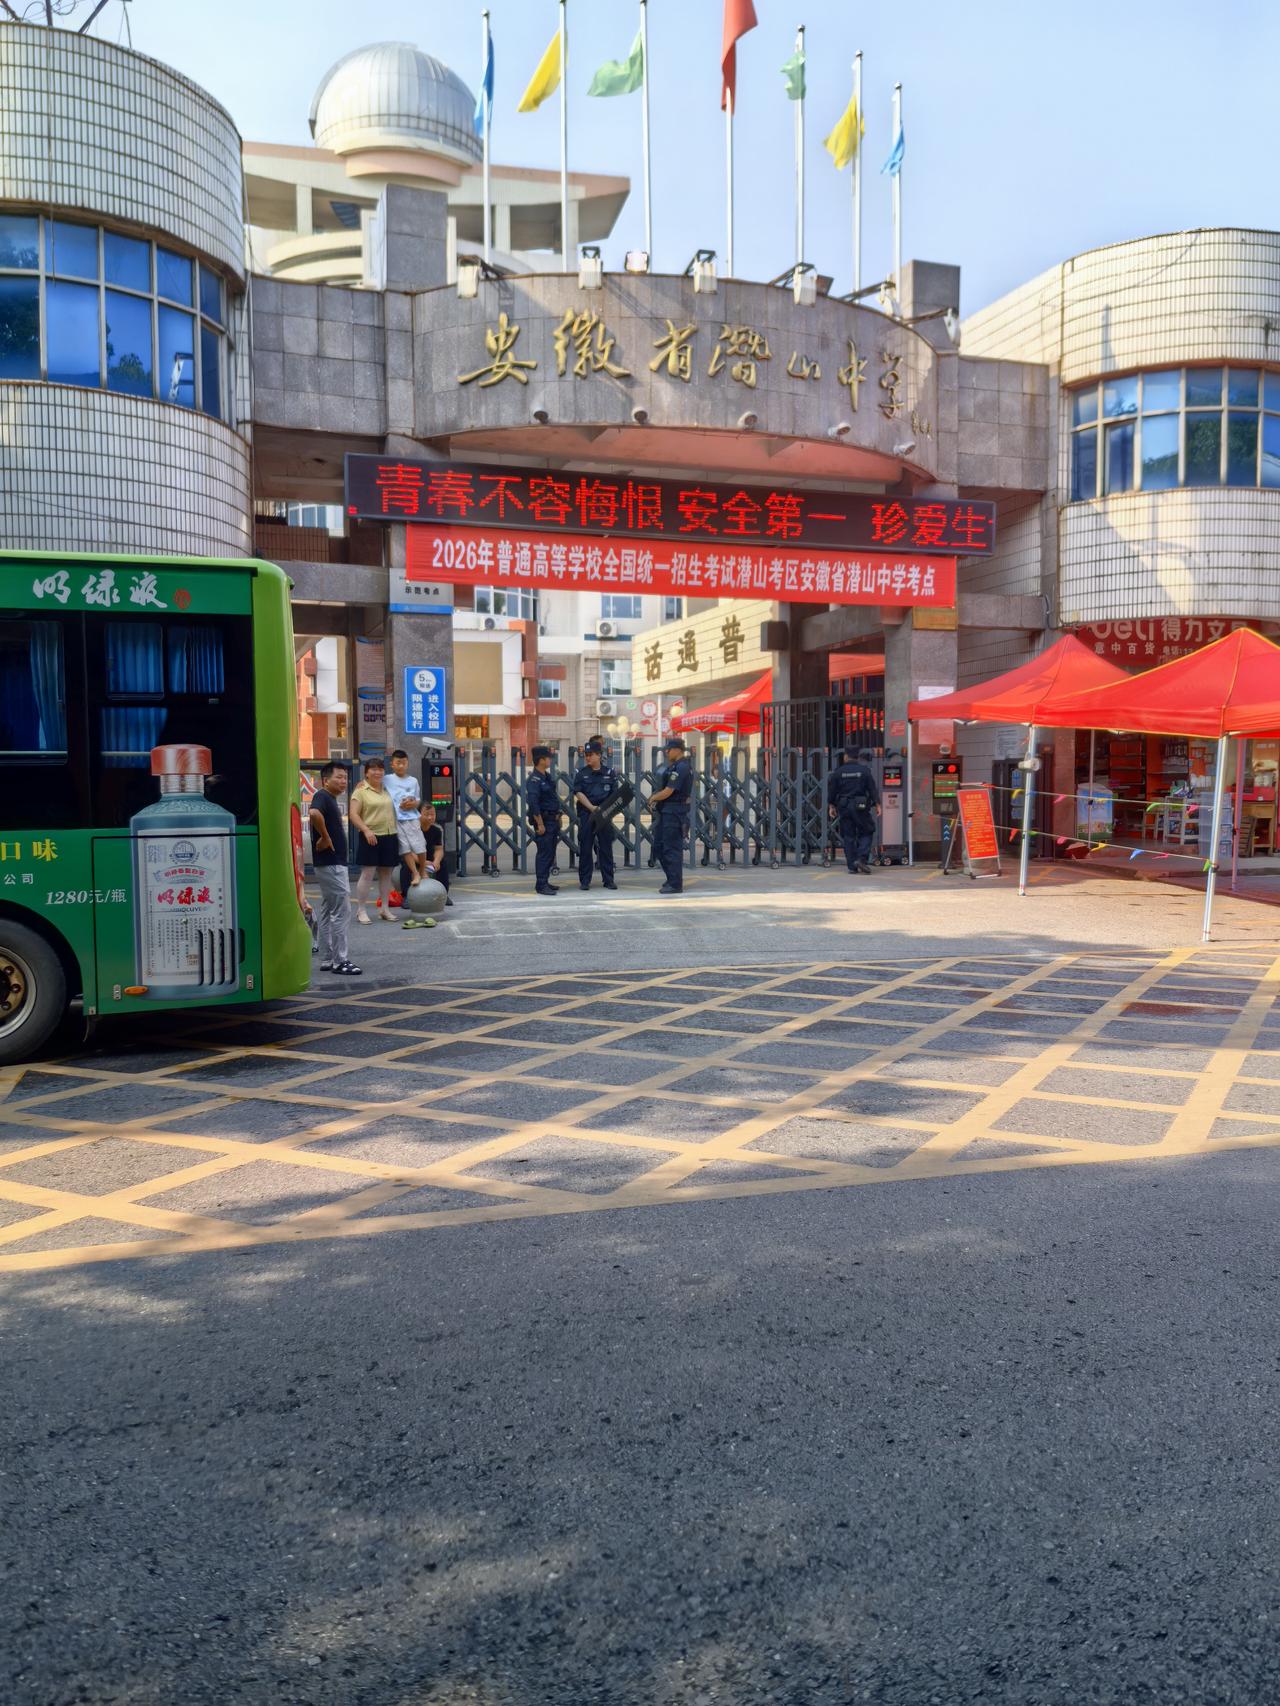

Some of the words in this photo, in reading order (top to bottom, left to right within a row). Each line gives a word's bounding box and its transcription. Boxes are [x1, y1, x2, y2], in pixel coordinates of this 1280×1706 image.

[678, 487, 847, 539] 安全第一
[432, 538, 935, 596] 2026年普通高等学校全国统一招生考试潜山考区安徽省潜山中学考点
[1, 839, 58, 861] 口味
[4, 873, 34, 885] 公司
